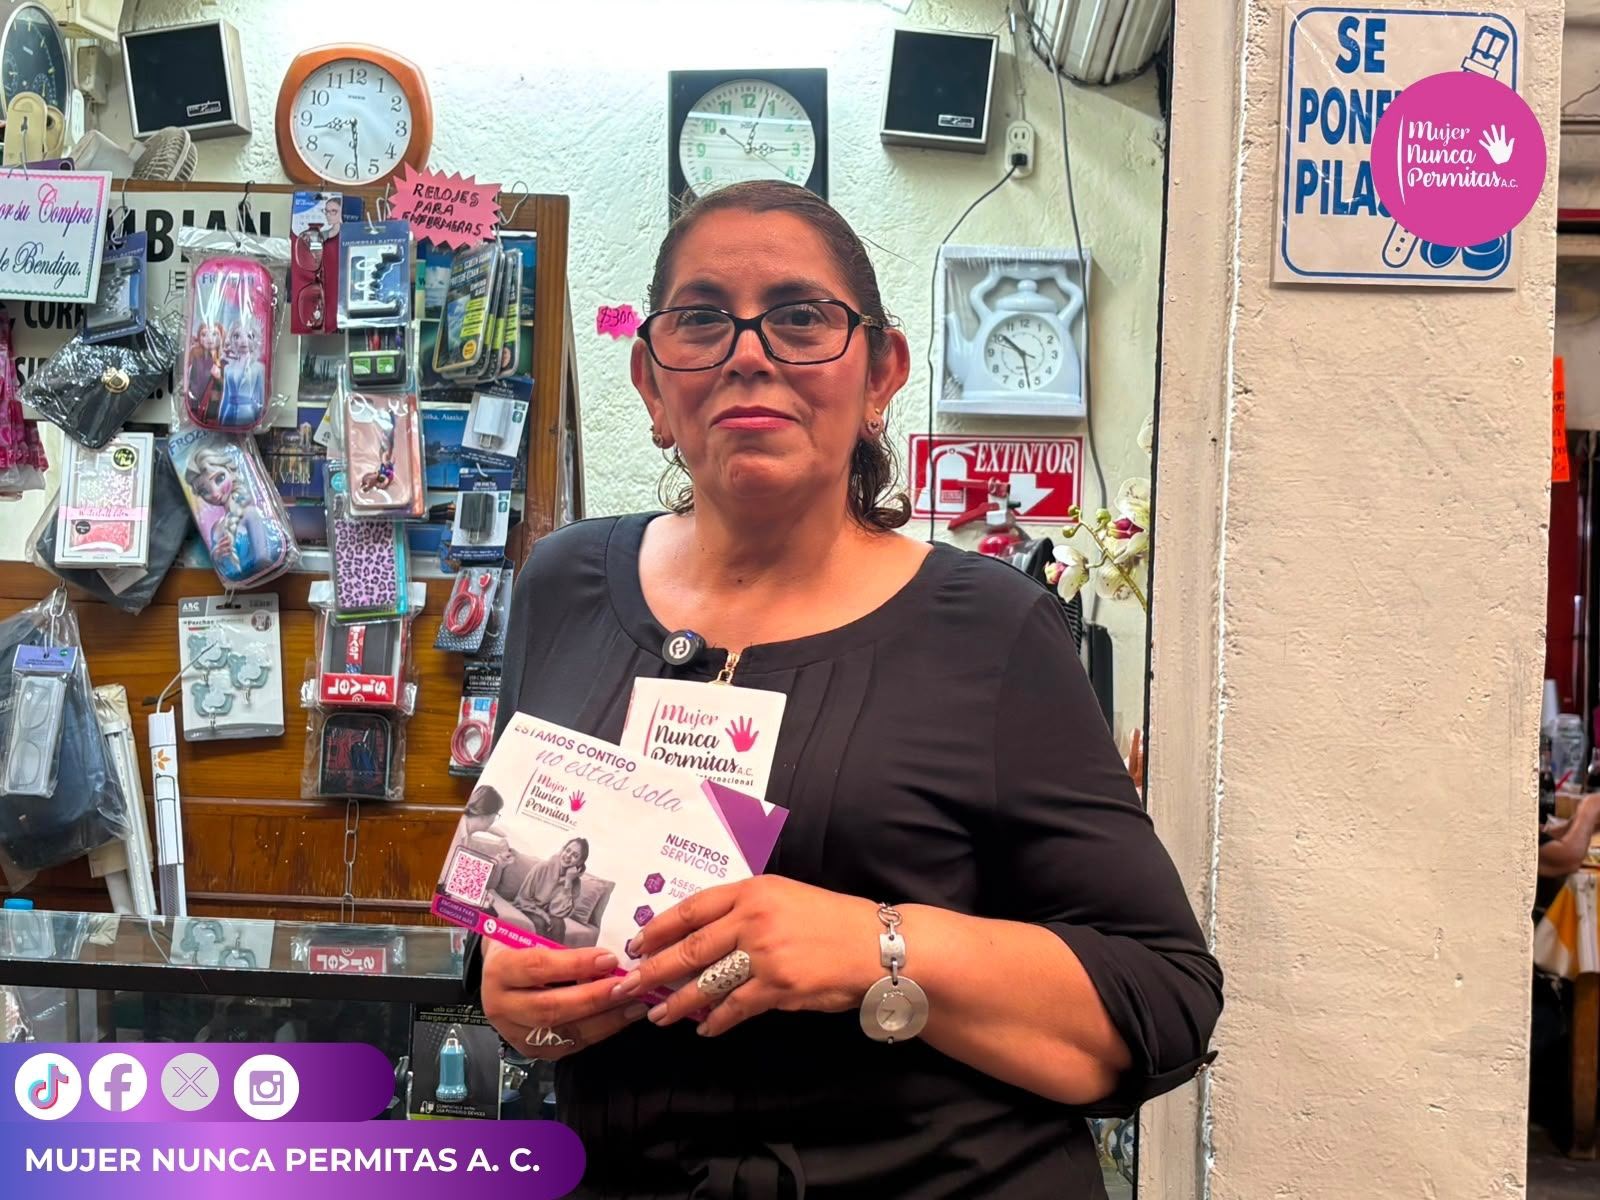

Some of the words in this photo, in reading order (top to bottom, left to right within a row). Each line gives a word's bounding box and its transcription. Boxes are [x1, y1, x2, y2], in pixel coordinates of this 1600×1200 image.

[1335, 15, 1387, 74] SE
[328, 73, 343, 89] 11
[348, 68, 368, 85] 12
[377, 77, 384, 94] 1
[311, 90, 330, 106] 10
[391, 96, 403, 113] 2
[741, 93, 756, 108] 12
[719, 100, 732, 115] 11
[768, 101, 776, 116] 1
[301, 110, 313, 127] 9
[1298, 87, 1403, 145] PONE
[395, 120, 408, 137] 3
[701, 119, 717, 133] 10
[306, 135, 318, 151] 8
[385, 141, 397, 160] 4
[696, 143, 706, 157] 9
[791, 142, 801, 157] 3
[323, 154, 334, 170] 7
[368, 159, 380, 175] 5
[344, 162, 357, 179] 6
[413, 183, 480, 208] RELOJES
[14, 200, 30, 221] su
[38, 183, 94, 237] Compra
[414, 201, 454, 216] PARA
[13, 241, 81, 290] Bendiga.
[1007, 322, 1014, 331] 11
[1020, 319, 1030, 328] 12
[1038, 323, 1041, 332] 1
[992, 334, 1004, 343] 10
[1047, 335, 1054, 344] 2
[987, 348, 995, 357] 9
[1051, 350, 1058, 359] 3
[992, 364, 999, 374] 8
[1045, 366, 1052, 375] 4
[1002, 375, 1009, 384] 7
[1018, 379, 1025, 389] 6
[1034, 377, 1041, 386] 5
[974, 441, 1074, 474] EXTINTOR
[661, 704, 718, 730] Mujer
[654, 725, 720, 749] Nunca
[514, 723, 575, 751] ESTAMOS
[576, 743, 637, 773] CONTIGO
[651, 747, 740, 773] Permitas
[535, 750, 565, 767] no
[565, 761, 632, 791] estás
[632, 783, 683, 813] sola
[538, 774, 568, 793] Mujer
[531, 785, 565, 806] Nunca
[525, 797, 570, 825] Permitas
[665, 833, 730, 866] NUESTROS
[660, 845, 728, 878] SERVICIOS
